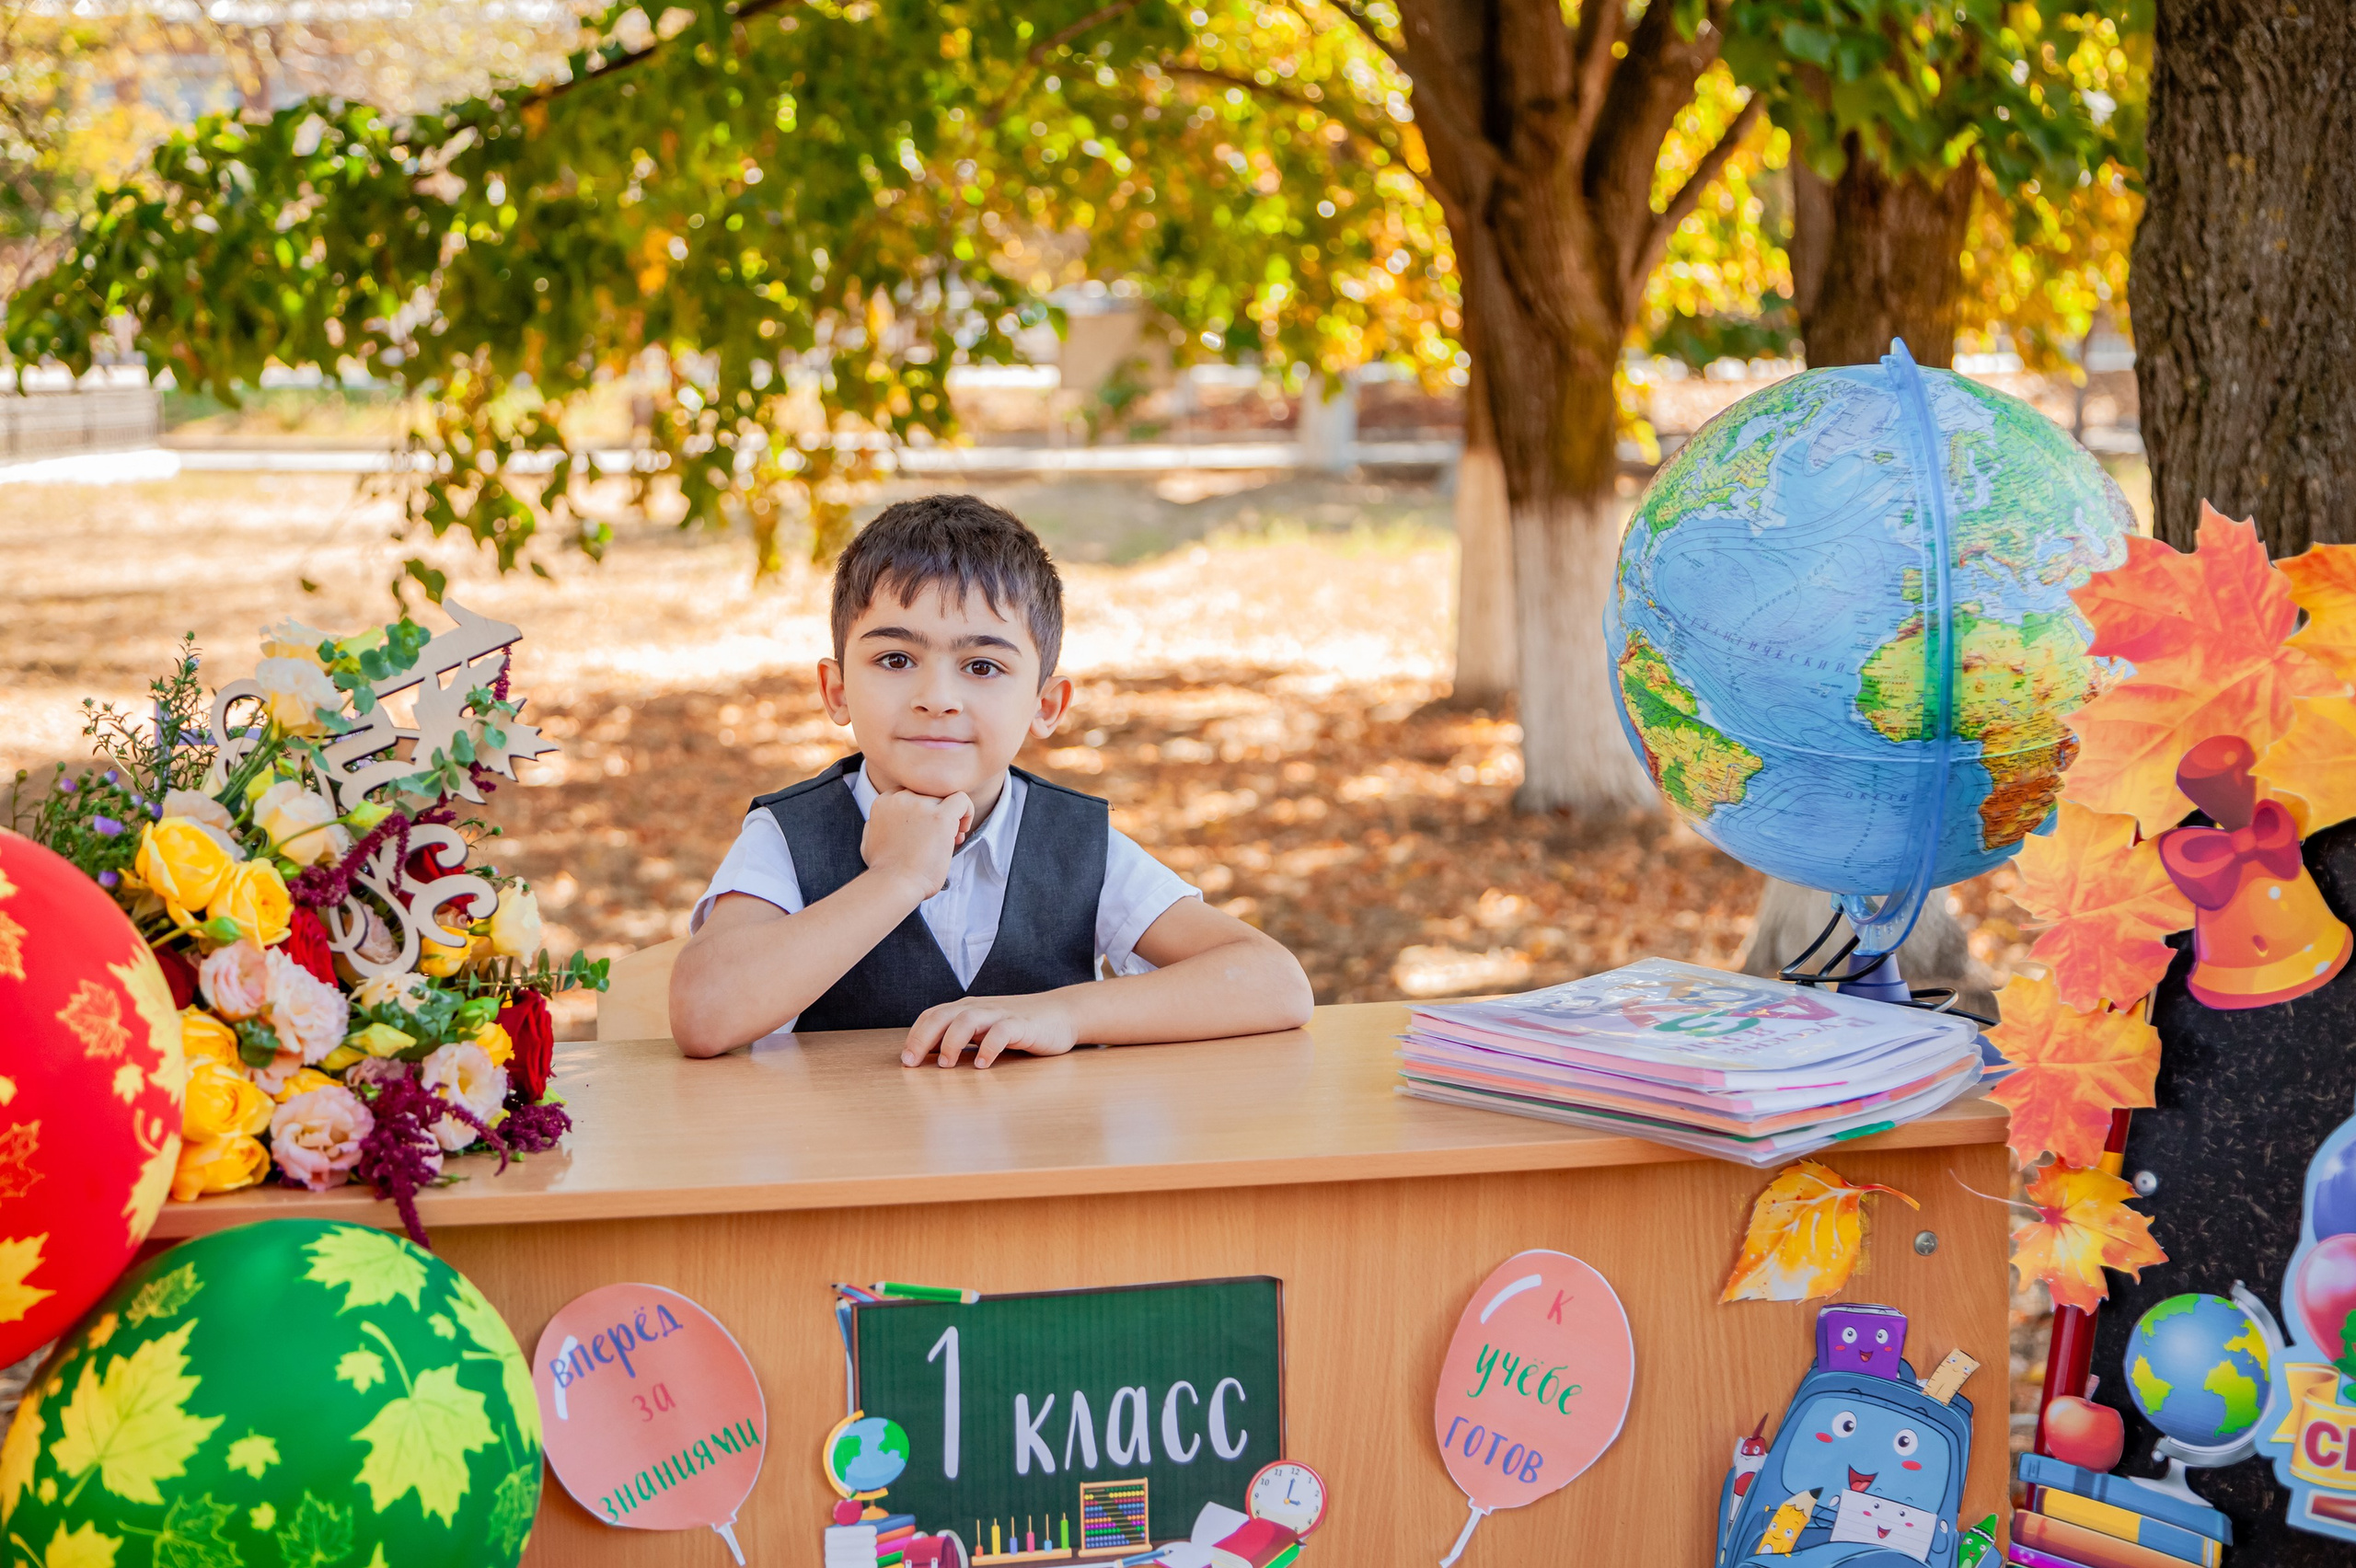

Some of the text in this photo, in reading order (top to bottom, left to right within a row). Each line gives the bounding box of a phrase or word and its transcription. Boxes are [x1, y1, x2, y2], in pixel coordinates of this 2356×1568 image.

[1680, 613, 1846, 674] АТЛАНТИЧЕСКИЙ
[1844, 790, 1910, 801] ОКЕАН
[549, 1304, 684, 1389] вперёд
[631, 1383, 676, 1423] за
[928, 1325, 1248, 1479] 1 класс
[1467, 1343, 1583, 1415] учёбе
[598, 1418, 760, 1526] знаниями
[1260, 1478, 1270, 1486] 10
[1274, 1469, 1283, 1477] 11
[1291, 1468, 1300, 1476] 12
